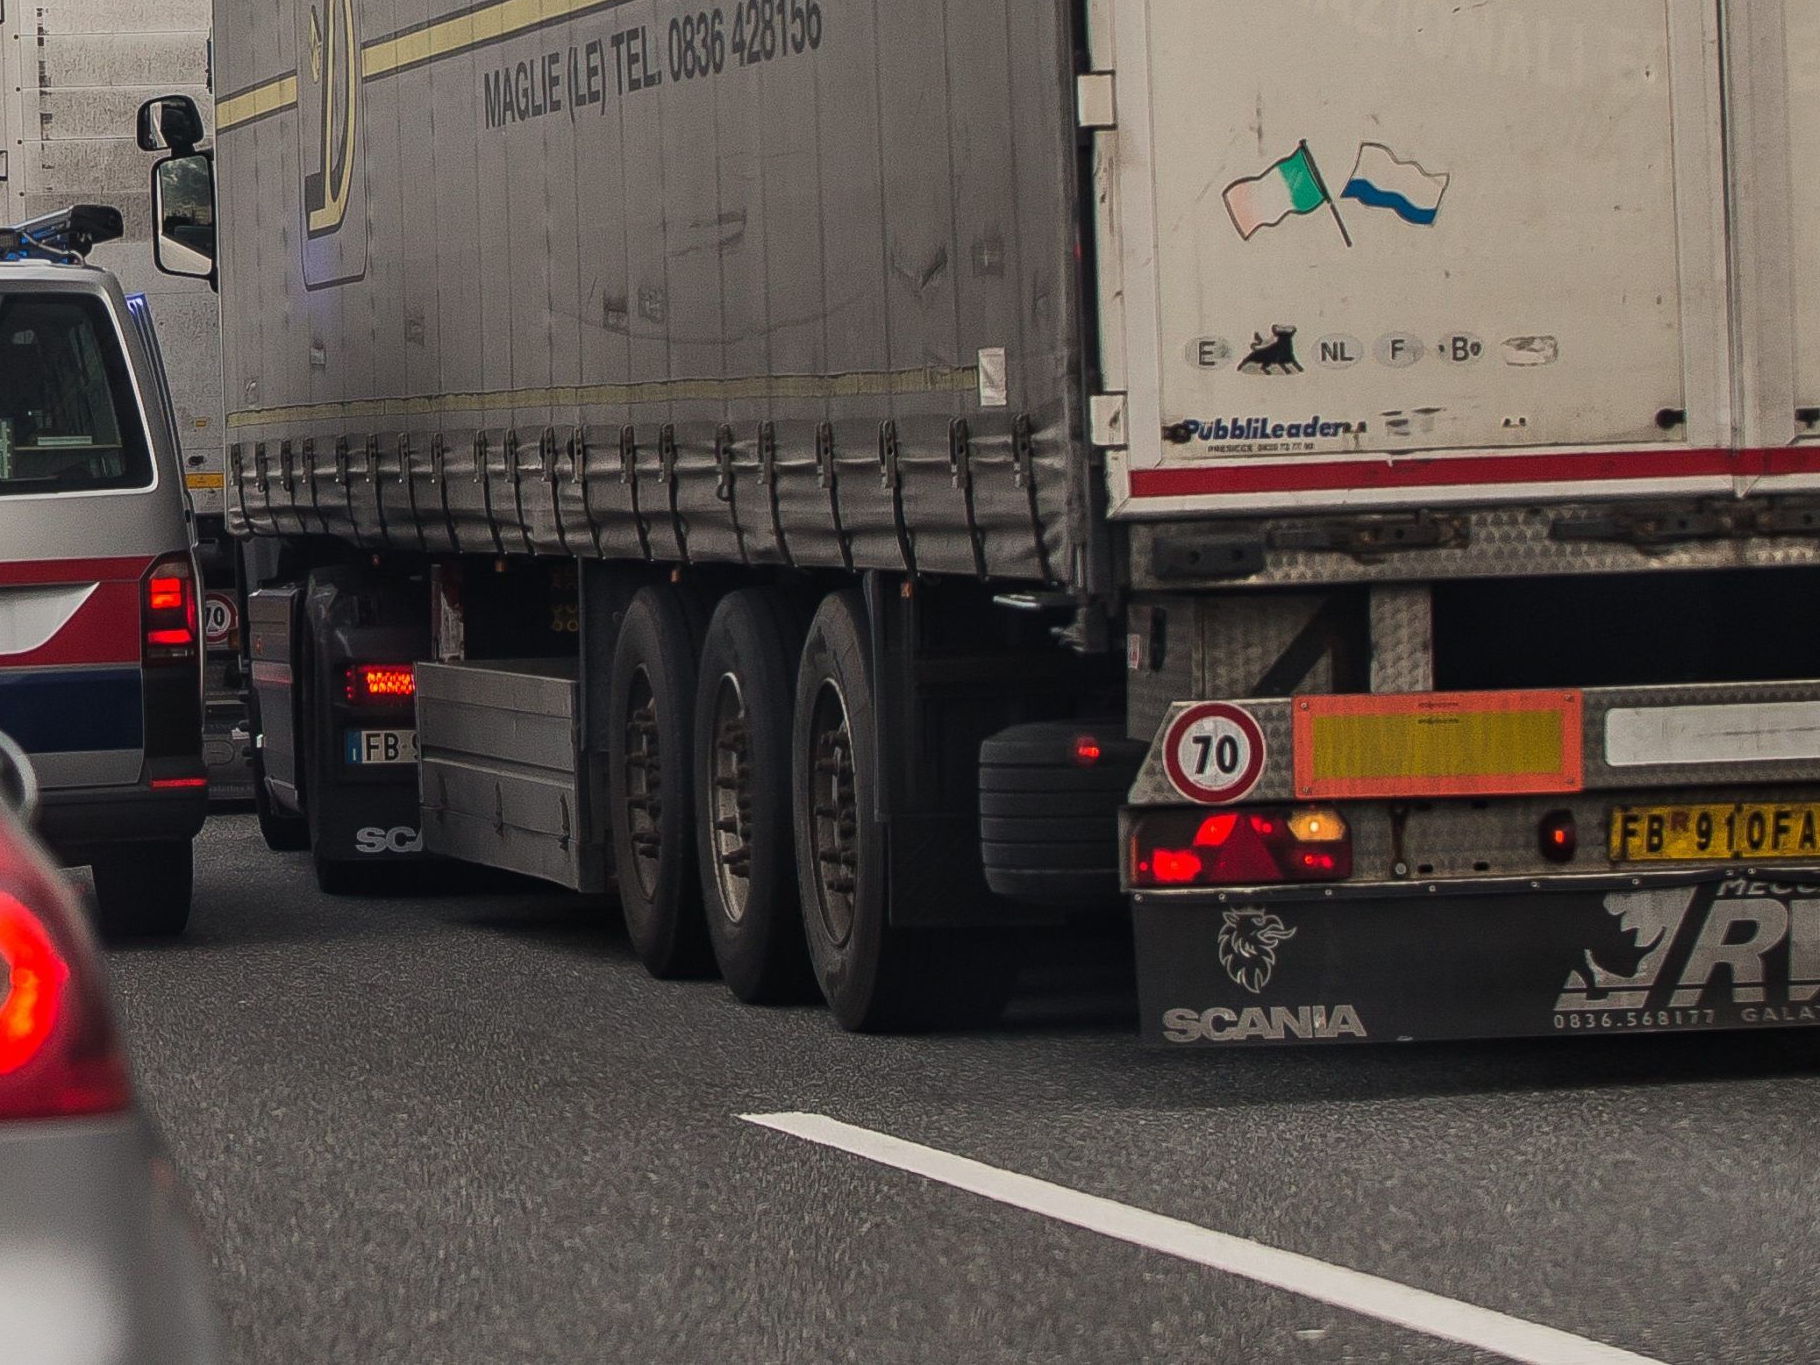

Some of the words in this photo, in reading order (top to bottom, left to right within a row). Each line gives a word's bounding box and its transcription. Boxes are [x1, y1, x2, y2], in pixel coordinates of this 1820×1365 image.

[483, 51, 562, 130] MAGLIE
[566, 37, 606, 124] (LE)
[610, 25, 663, 96] TEL.
[668, 7, 726, 83] 0836
[1320, 341, 1355, 363] NL
[1390, 338, 1406, 362] F
[365, 732, 400, 762] FB
[1192, 734, 1238, 775] 70
[1621, 811, 1664, 853] FB
[1695, 809, 1818, 852] 910FA
[1162, 1004, 1367, 1043] SCANIA
[1553, 1009, 1716, 1029] 0836.568177
[1740, 1005, 1820, 1023] GALA
